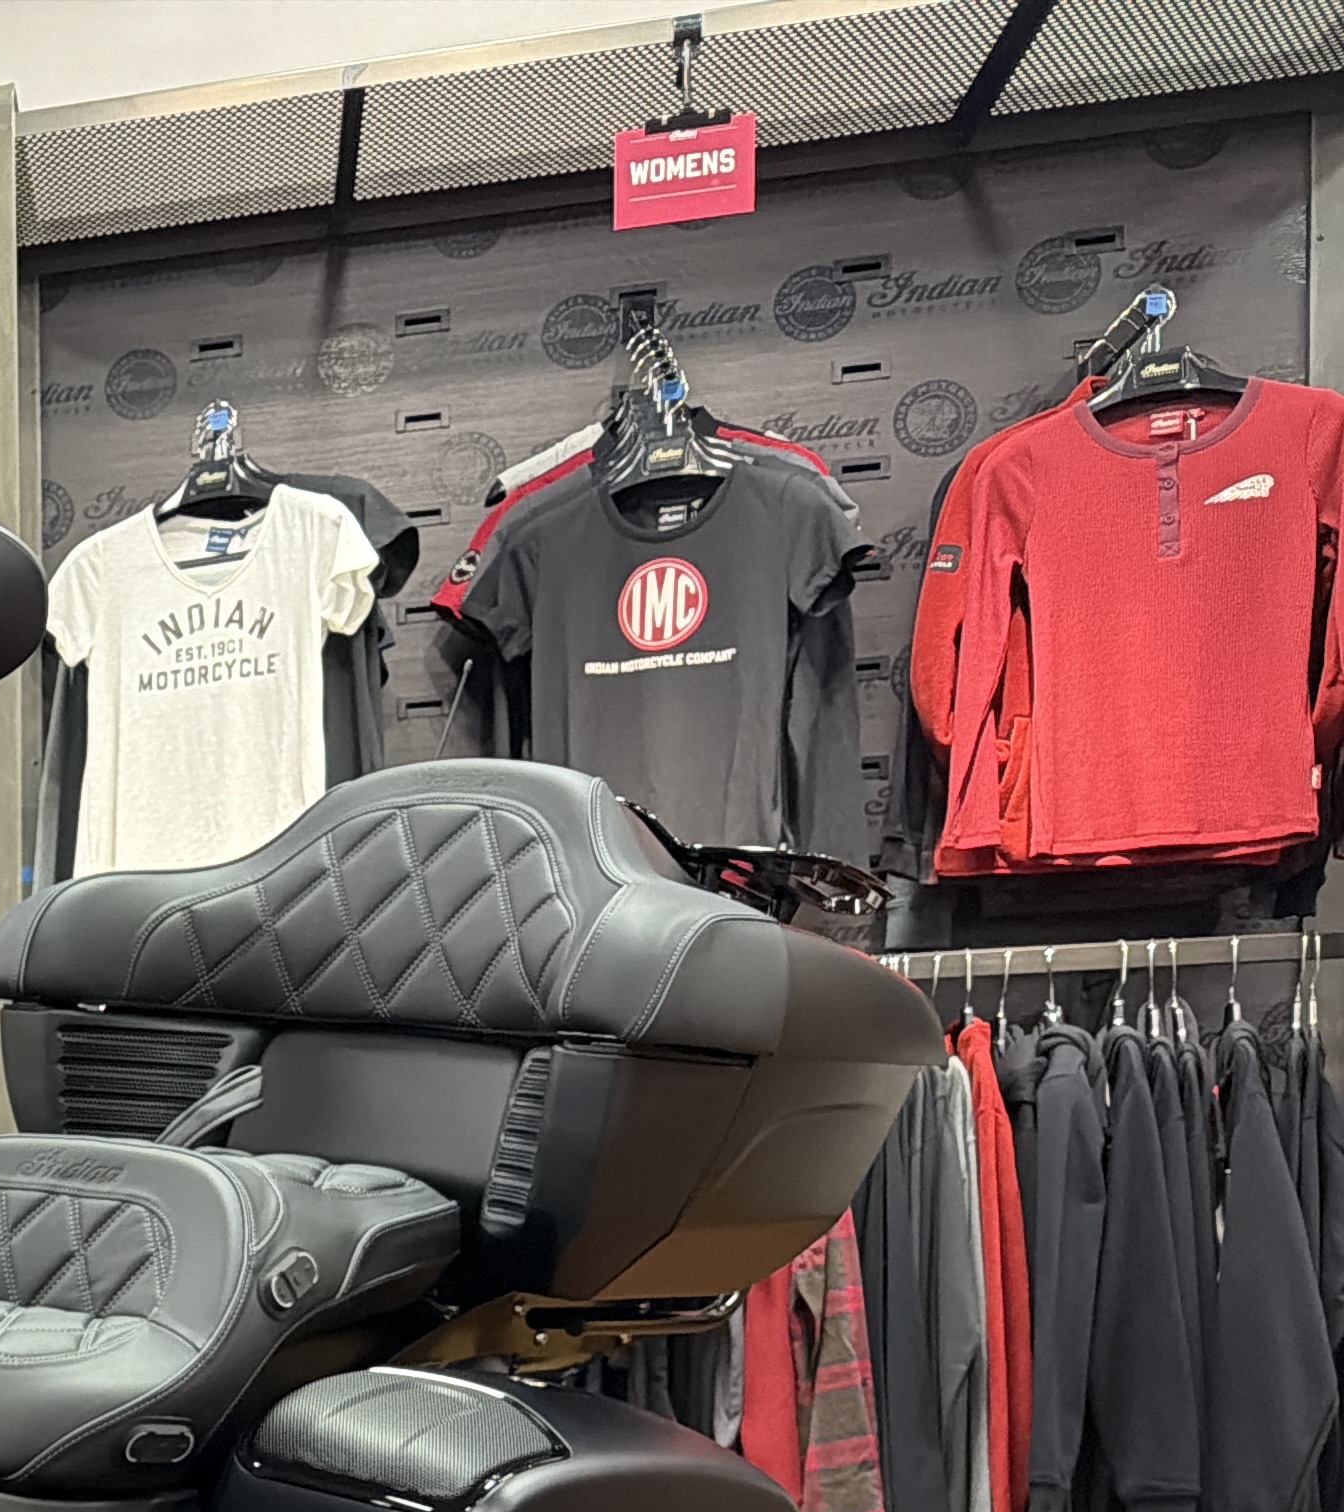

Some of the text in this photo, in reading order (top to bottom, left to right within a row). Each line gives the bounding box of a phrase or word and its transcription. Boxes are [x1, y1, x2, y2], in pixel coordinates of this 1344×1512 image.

[630, 148, 736, 186] WOMENS
[867, 270, 1003, 308] Indian
[631, 567, 697, 641] IMC
[141, 597, 275, 656] INDIAN
[138, 653, 279, 693] MOTORCYCLE
[584, 660, 619, 675] INDIAN
[620, 654, 683, 674] MOTORCYCLE
[685, 648, 733, 666] COMPANY
